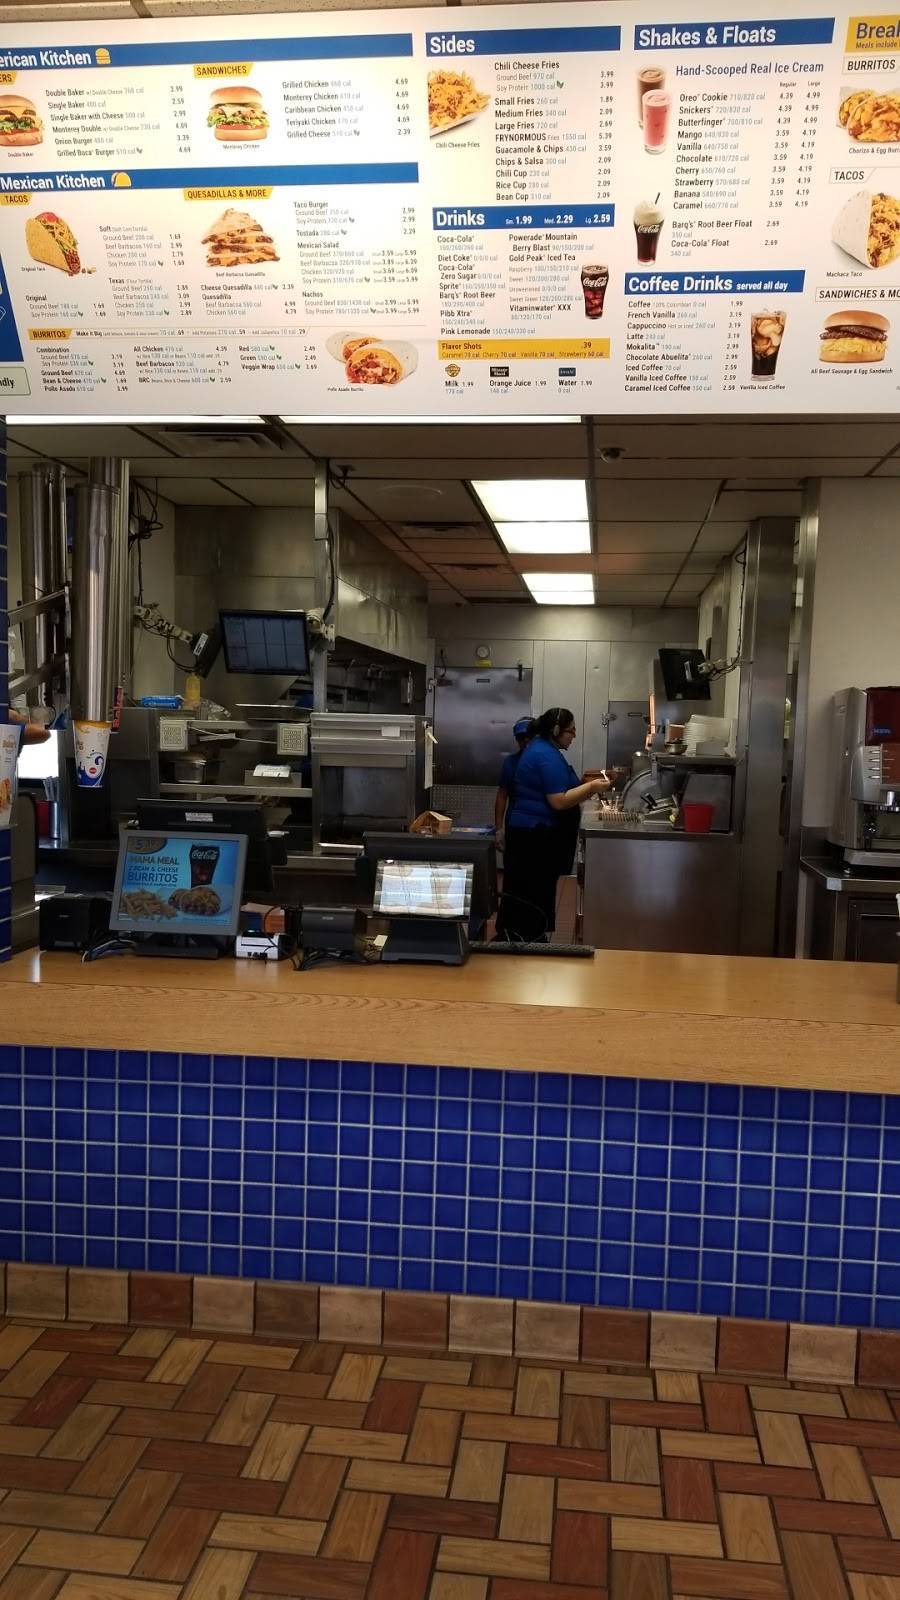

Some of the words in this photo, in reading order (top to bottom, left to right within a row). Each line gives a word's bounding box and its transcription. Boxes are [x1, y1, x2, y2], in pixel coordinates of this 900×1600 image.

[639, 28, 701, 46] Shakes
[705, 27, 717, 44] &
[723, 25, 776, 44] Floats
[430, 35, 475, 53] Sides
[856, 41, 874, 49] Meals
[40, 50, 91, 66] Kitchen
[494, 62, 511, 71] Chili
[541, 61, 560, 69] Fries
[676, 64, 747, 77] Hand-Scooped
[750, 63, 771, 74] Real
[775, 63, 789, 73] Ice
[792, 62, 824, 73] Cream
[847, 59, 896, 71] BURRITOS
[196, 66, 247, 76] SANDWICHES
[282, 81, 303, 89] Grilled
[304, 80, 329, 88] Chicken
[45, 89, 66, 97] Double
[283, 93, 312, 102] Monterey
[48, 102, 67, 110] Single
[495, 98, 515, 106] Small
[516, 97, 534, 105] Fries
[317, 105, 342, 113] Chicken
[495, 109, 524, 118] Medium
[525, 109, 543, 117] Fries
[50, 114, 69, 122] Single
[286, 118, 310, 127] Teriyaki
[52, 126, 80, 135] Monterey
[495, 122, 516, 131] Large
[518, 121, 535, 129] Fries
[287, 130, 308, 138] Grilled
[309, 130, 331, 138] Cheese
[495, 133, 546, 142] FRYNORMOUS
[677, 131, 702, 140] Mango
[73, 137, 93, 146] Burger
[495, 145, 535, 154] Guacamole
[536, 145, 541, 153] &
[543, 145, 564, 154] Chips
[677, 143, 702, 151] Vanilla
[496, 158, 516, 167] Chips
[524, 157, 544, 165] Salsa
[513, 170, 528, 178] Cup
[675, 167, 699, 176] Cherry
[834, 171, 865, 180] TACOS
[1, 177, 54, 190] Mexican
[57, 175, 105, 188] Kitchen
[513, 181, 527, 190] Cup
[675, 179, 714, 187] Strawberry
[188, 191, 238, 199] QUESADILLAS
[239, 190, 244, 198] &
[245, 189, 267, 198] MORE
[496, 193, 513, 201] Bean
[515, 193, 529, 202] Cup
[674, 190, 701, 198] Banana
[5, 195, 28, 203] TACOS
[308, 201, 328, 209] Burger
[673, 202, 703, 210] Caramel
[436, 210, 485, 226] Drinks
[516, 215, 532, 224] 1.99
[556, 215, 573, 224] 2.29
[594, 214, 611, 223] 2.59
[513, 245, 531, 253] Berry
[457, 272, 477, 281] Sugar
[223, 284, 252, 292] Quesadilla
[628, 277, 679, 292] Coffee
[683, 276, 733, 291] Drinks
[737, 281, 760, 290] served
[761, 281, 773, 289] all
[774, 282, 788, 291] day
[819, 290, 877, 298] SANDWICHES
[880, 290, 885, 298] &
[652, 311, 676, 319] Vanilla
[261, 363, 275, 371] Wrap
[489, 380, 512, 388] Orange
[157, 857, 179, 865] MEAL
[127, 873, 178, 883] BURRITOS
